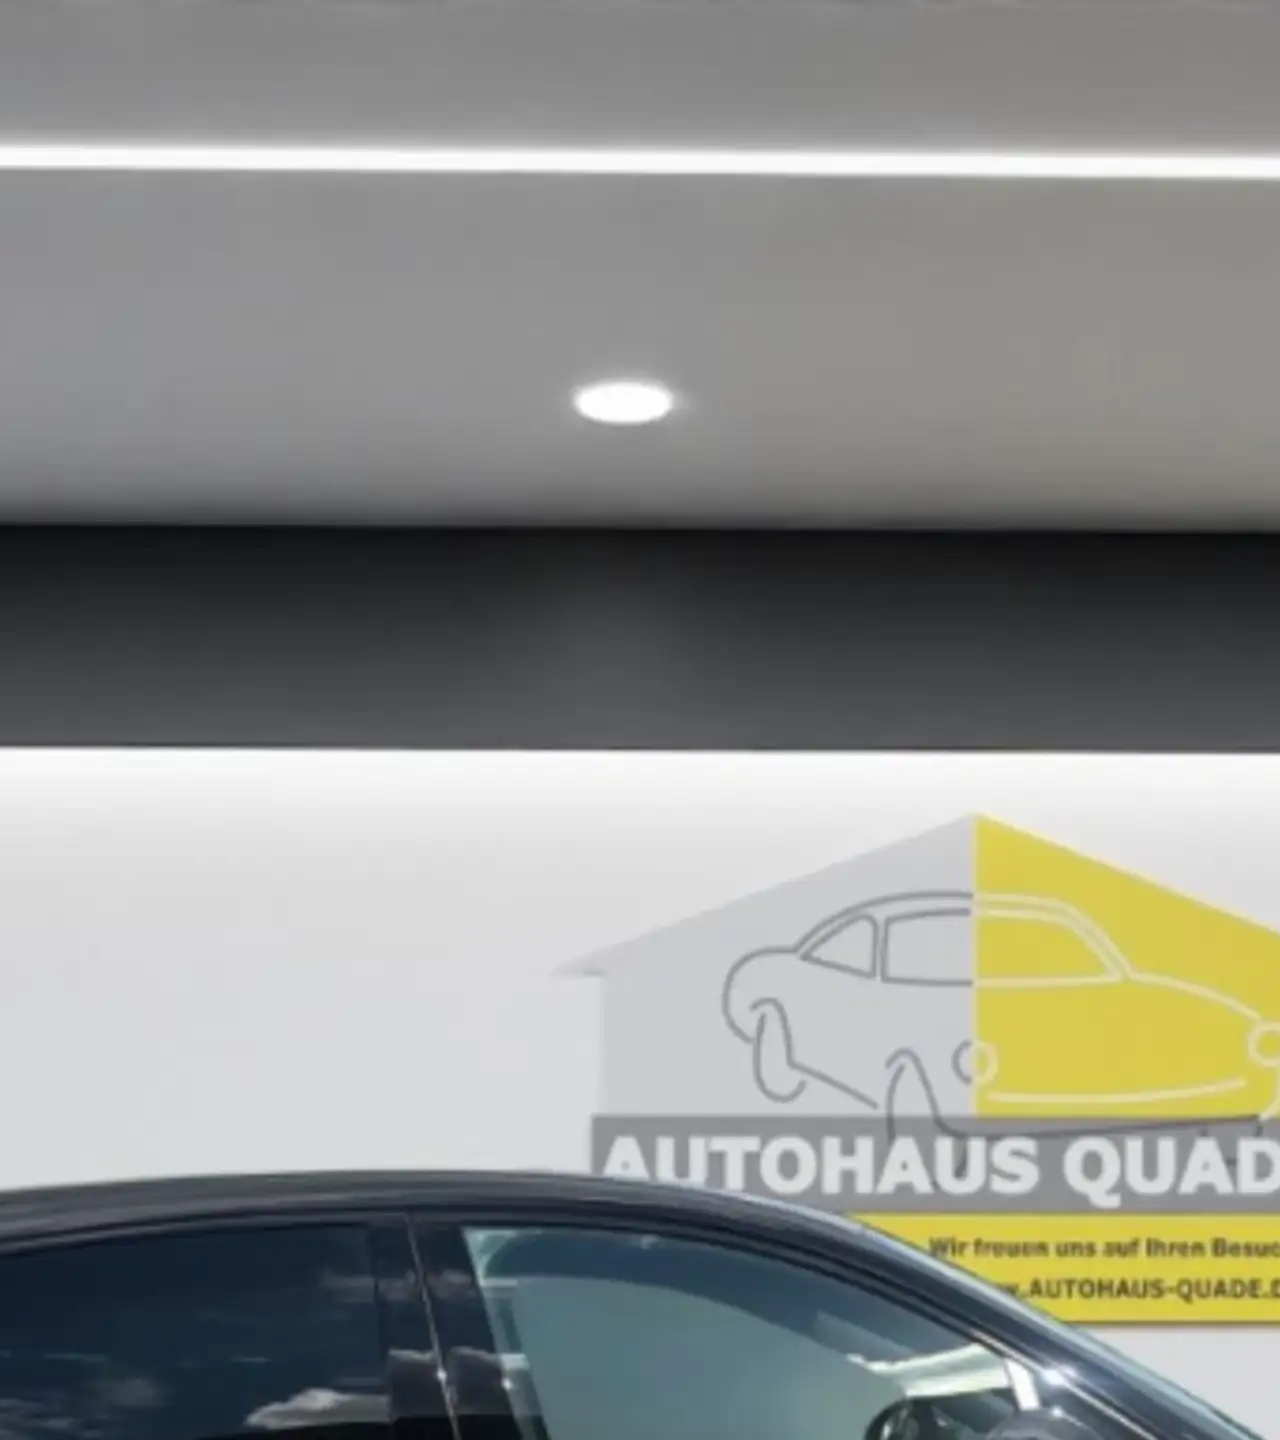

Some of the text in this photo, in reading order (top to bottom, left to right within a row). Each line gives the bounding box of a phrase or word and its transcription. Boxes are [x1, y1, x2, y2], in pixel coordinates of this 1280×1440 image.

[602, 1134, 1040, 1196] AUTOHAUS
[928, 1237, 967, 1258] Wir
[1056, 1241, 1096, 1258] uns
[1147, 1237, 1207, 1258] Ihren
